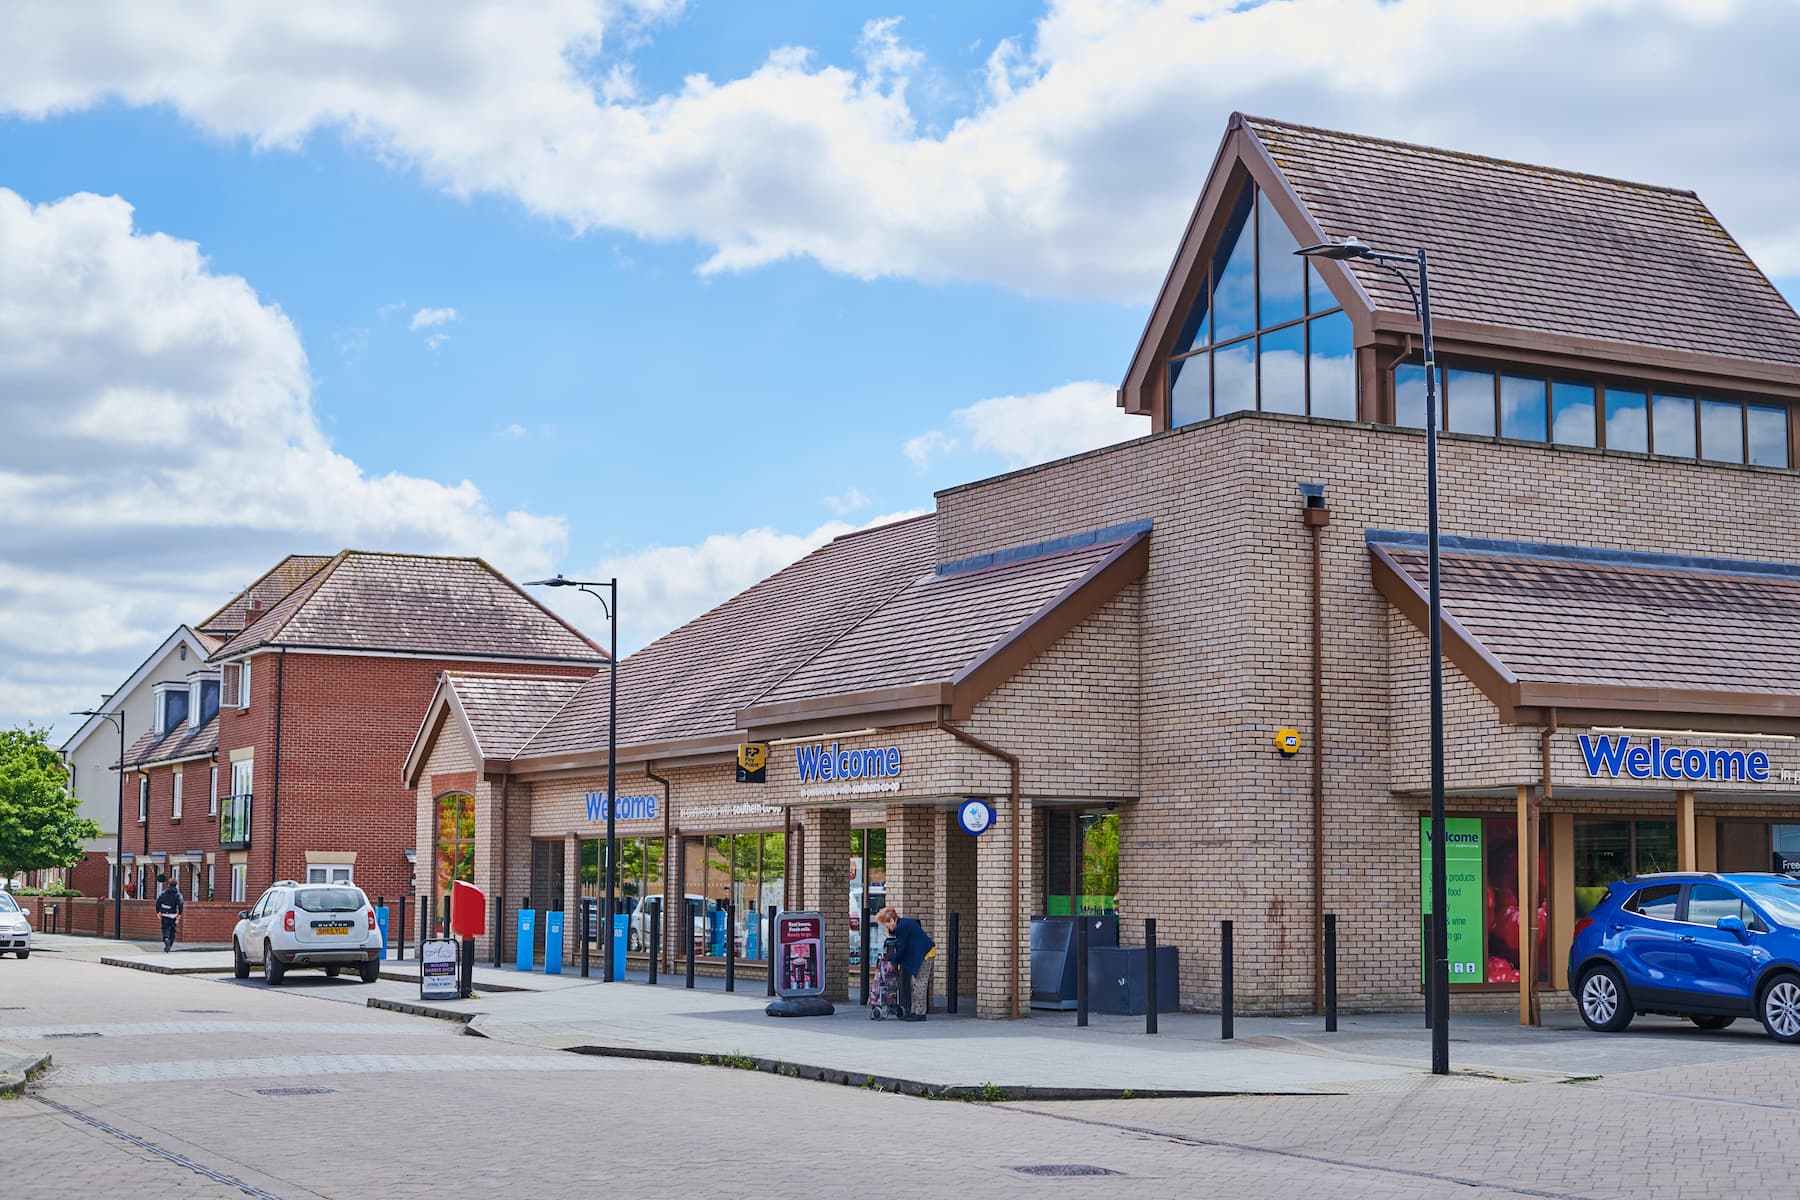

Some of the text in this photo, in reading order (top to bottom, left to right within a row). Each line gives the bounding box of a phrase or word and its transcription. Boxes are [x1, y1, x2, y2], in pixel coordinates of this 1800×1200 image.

[1285, 736, 1297, 746] ADT
[795, 742, 900, 782] Welcome
[1578, 734, 1769, 782] Welcome
[806, 785, 838, 799] partnership
[852, 782, 880, 793] southern
[880, 781, 900, 794] co-op
[585, 791, 658, 822] Wecome
[732, 801, 761, 815] southern
[1448, 872, 1476, 882] products
[1452, 917, 1466, 925] wine
